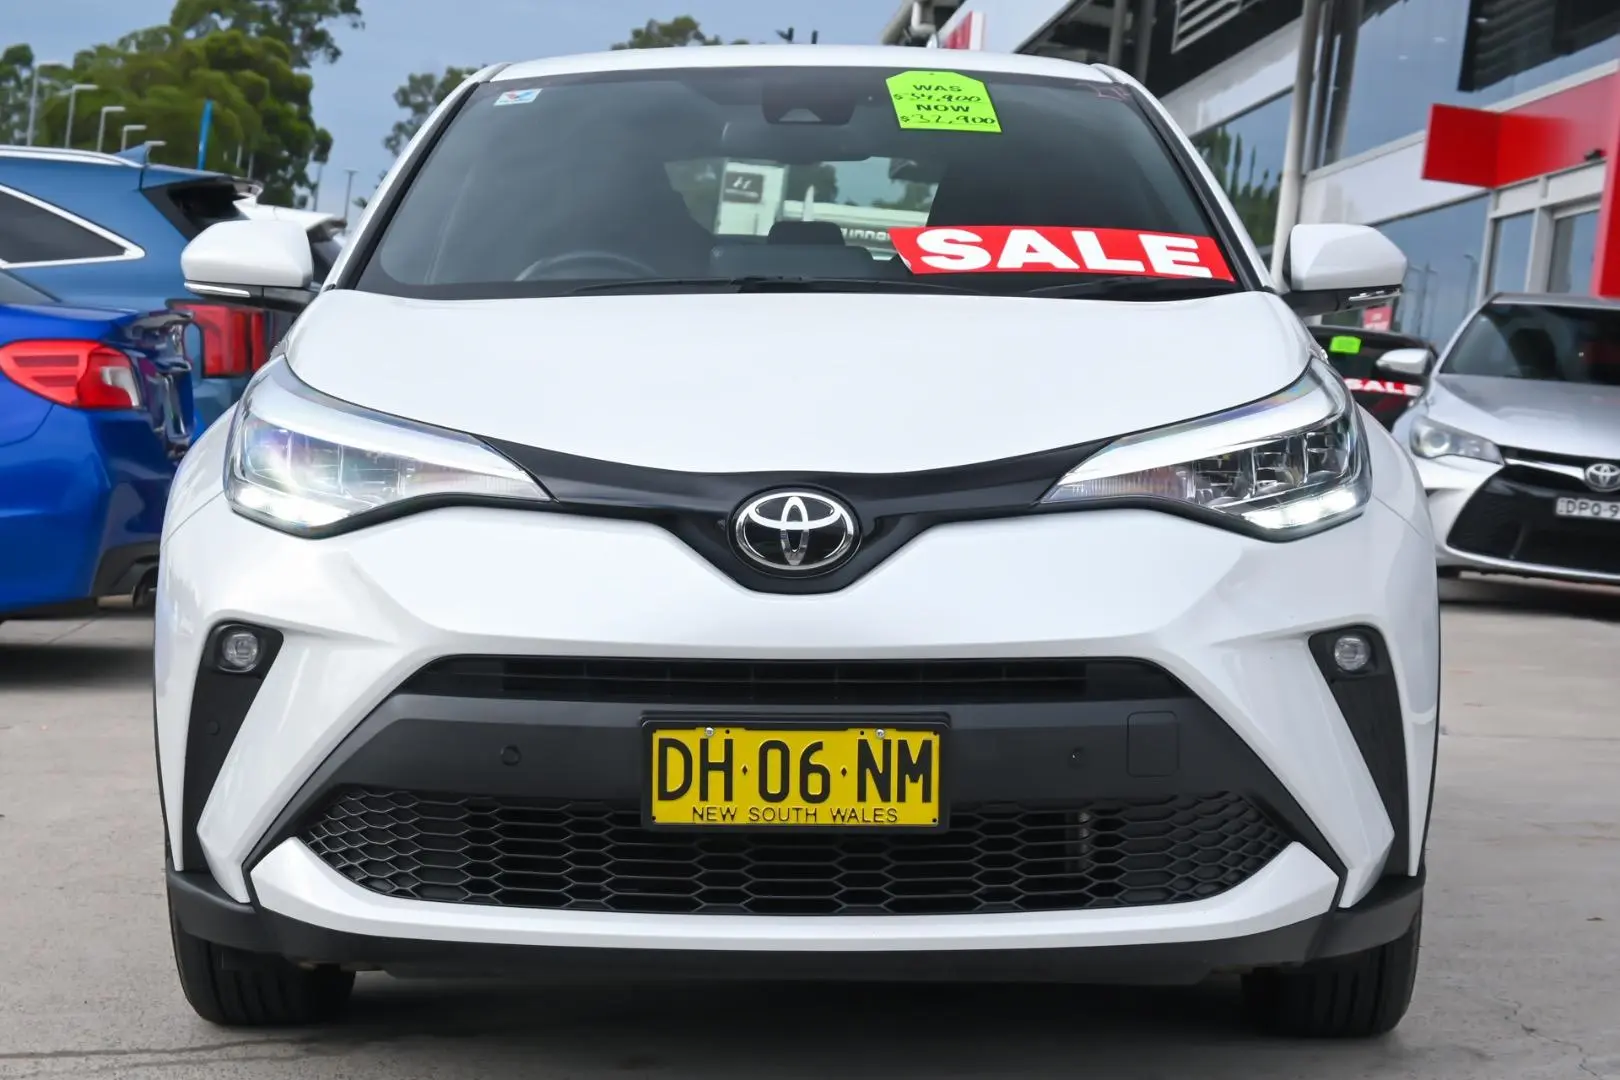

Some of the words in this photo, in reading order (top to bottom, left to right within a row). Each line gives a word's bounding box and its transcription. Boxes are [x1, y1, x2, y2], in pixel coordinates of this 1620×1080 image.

[912, 84, 962, 92] WAS
[915, 103, 970, 112] NOW
[916, 228, 1213, 279] SALE
[1344, 378, 1425, 397] SALE
[692, 806, 737, 822] NEW
[748, 807, 818, 823] SOUTH
[830, 807, 898, 823] WALES
